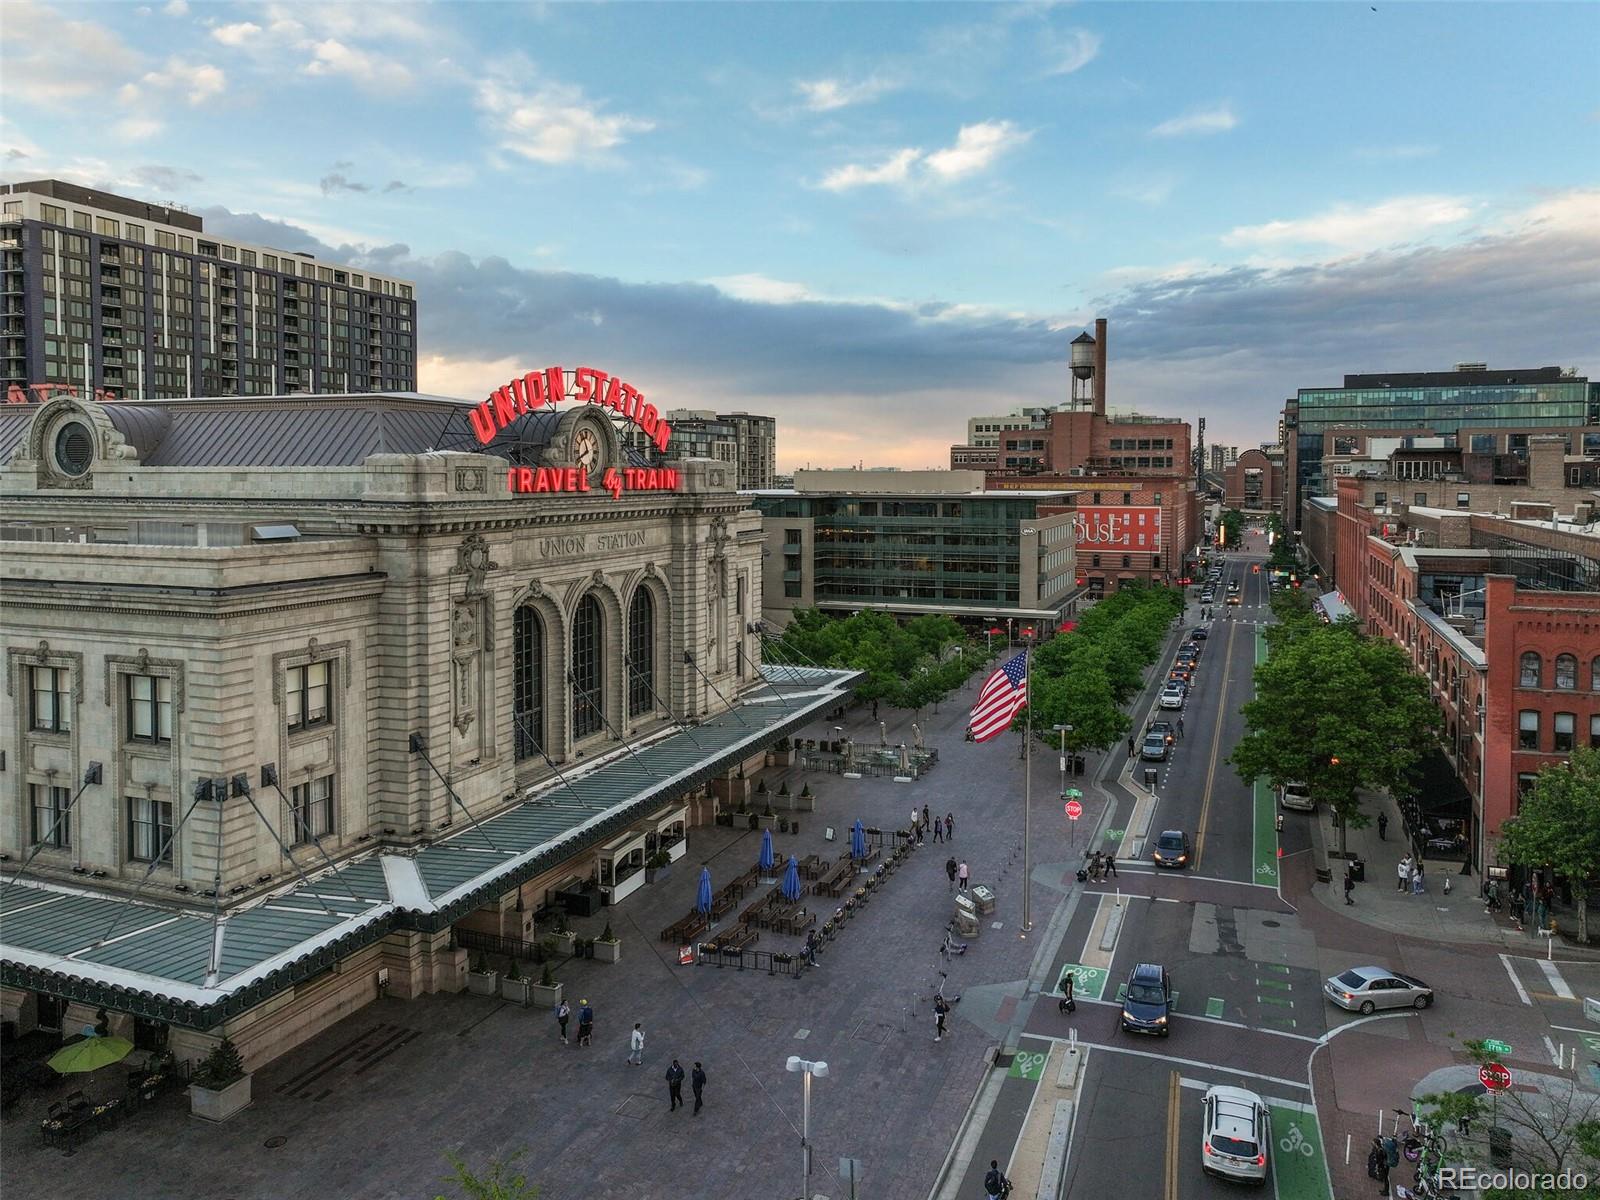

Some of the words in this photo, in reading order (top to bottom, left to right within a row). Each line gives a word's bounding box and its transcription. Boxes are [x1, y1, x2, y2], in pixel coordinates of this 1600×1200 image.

[468, 366, 565, 445] UNION
[575, 367, 672, 453] STATION
[508, 467, 592, 493] TRAVEL
[623, 467, 677, 490] TRAIN
[540, 535, 586, 558] UNION
[597, 529, 646, 551] STATION
[1066, 805, 1081, 814] STOP
